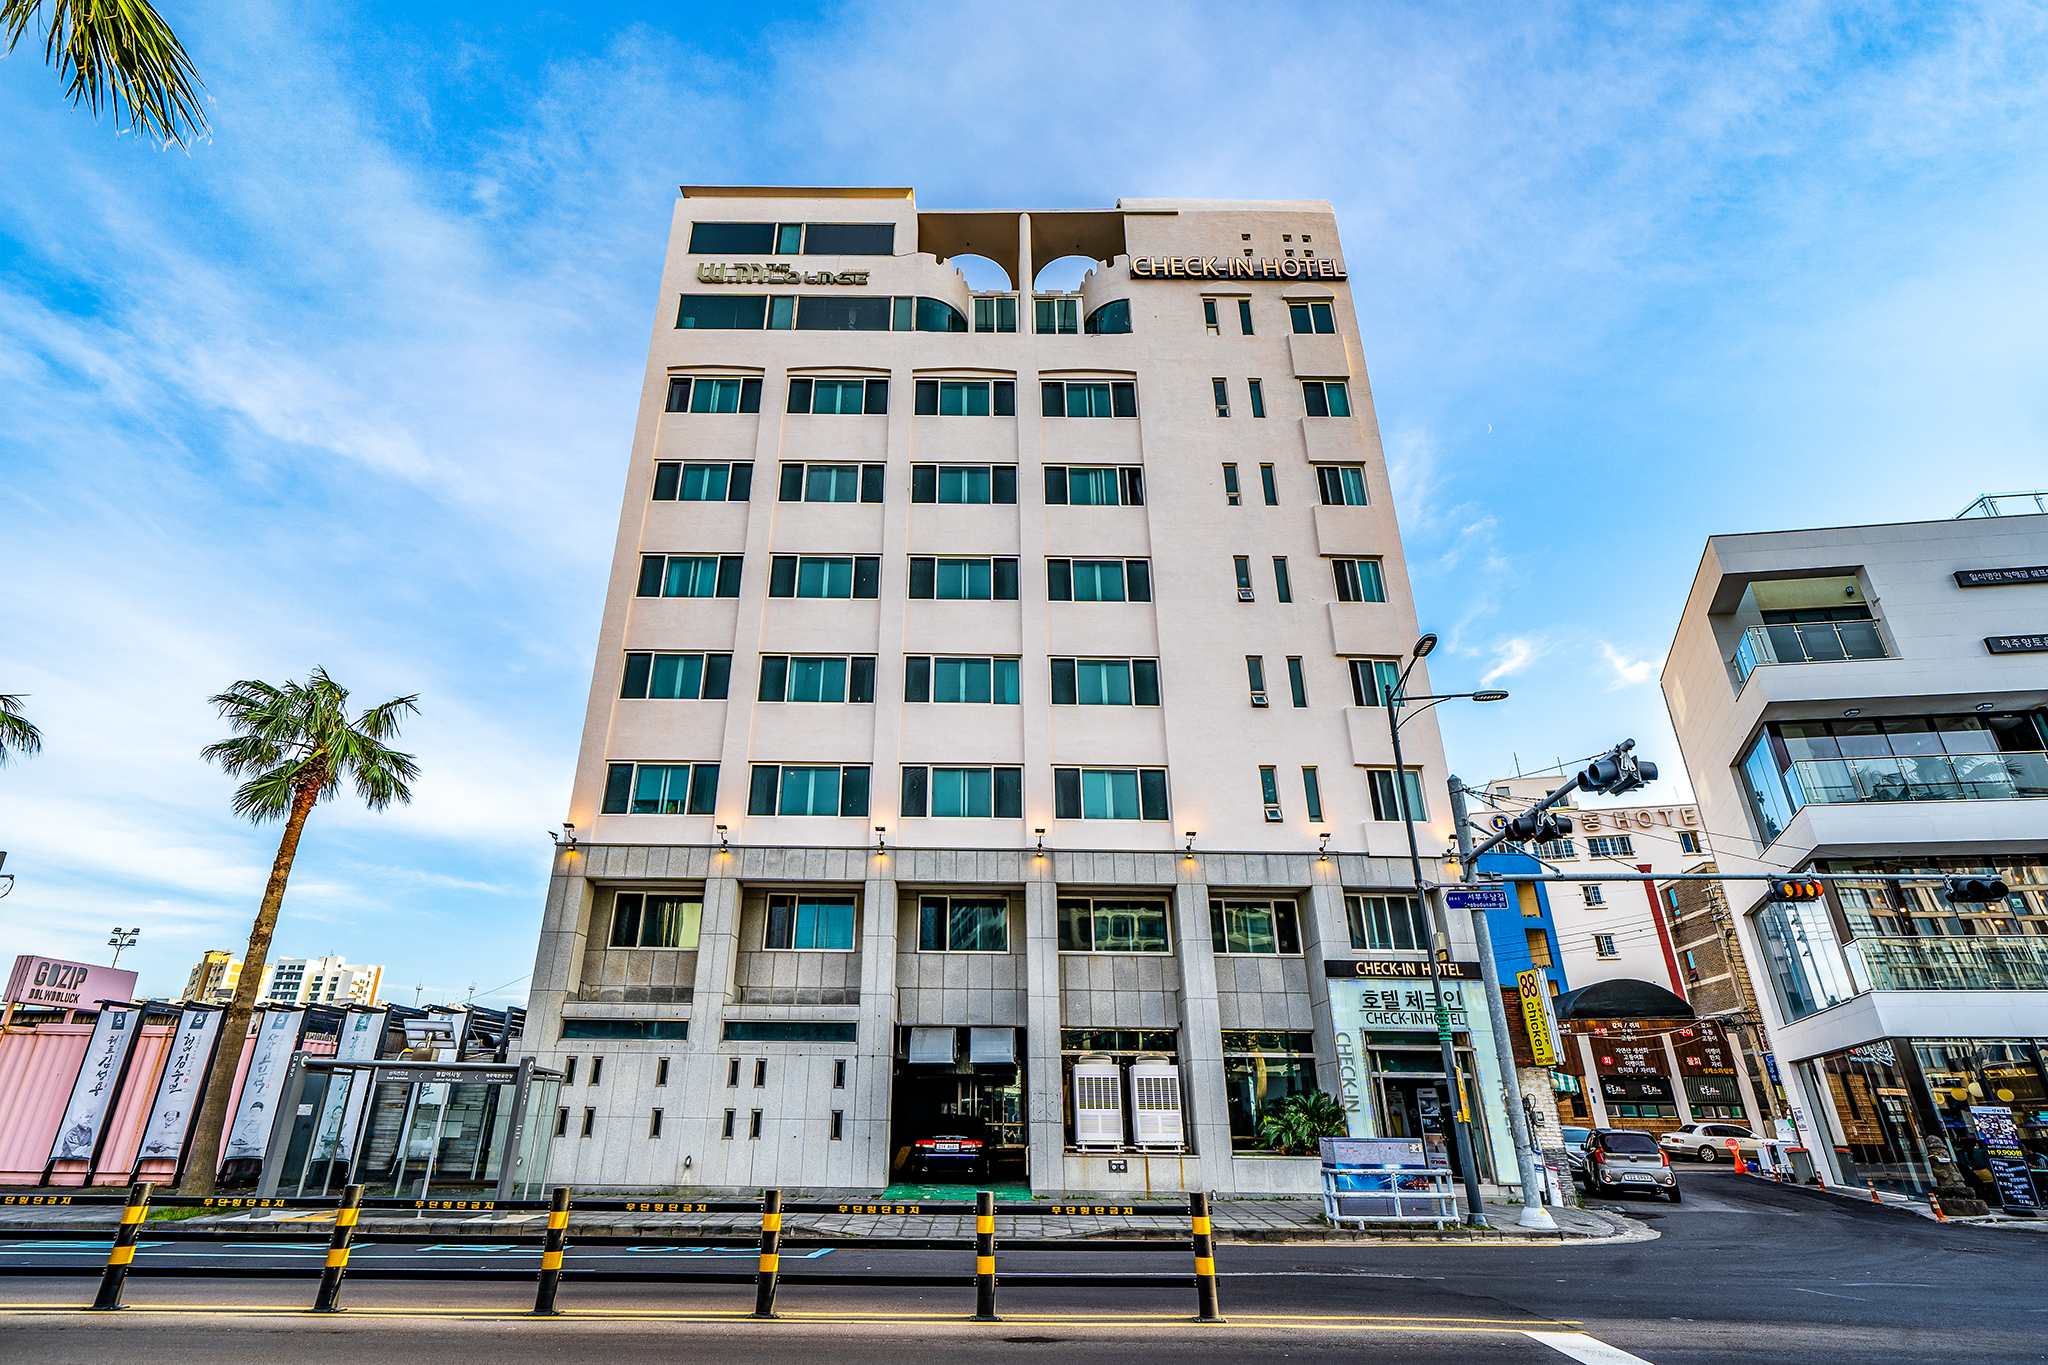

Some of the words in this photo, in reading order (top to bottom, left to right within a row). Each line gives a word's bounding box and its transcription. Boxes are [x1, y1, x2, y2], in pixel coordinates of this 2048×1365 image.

[1131, 255, 1255, 277] CHECK-IN
[1260, 257, 1348, 279] HOTEL
[34, 961, 88, 990] GOZIP
[1355, 961, 1416, 977] CHECK-IN
[1520, 973, 1538, 999] 88
[1361, 989, 1401, 1011] 호텔
[1404, 990, 1464, 1011] 체크인
[1366, 1012, 1424, 1026] CHECK-IN
[1425, 1013, 1466, 1026] HEL
[1526, 1002, 1545, 1056] chicken
[1679, 1028, 1694, 1037] 구이
[1336, 1032, 1361, 1113] CHECK-IN
[0, 1196, 71, 1206] 단횡단금지
[203, 1198, 286, 1208] 무단횡단금지
[414, 1200, 495, 1210] 무단횡단금지
[625, 1203, 707, 1212] 무단횡단금지
[838, 1205, 920, 1215] 무단횡단금지
[1051, 1206, 1134, 1216] 무단횡단금지
